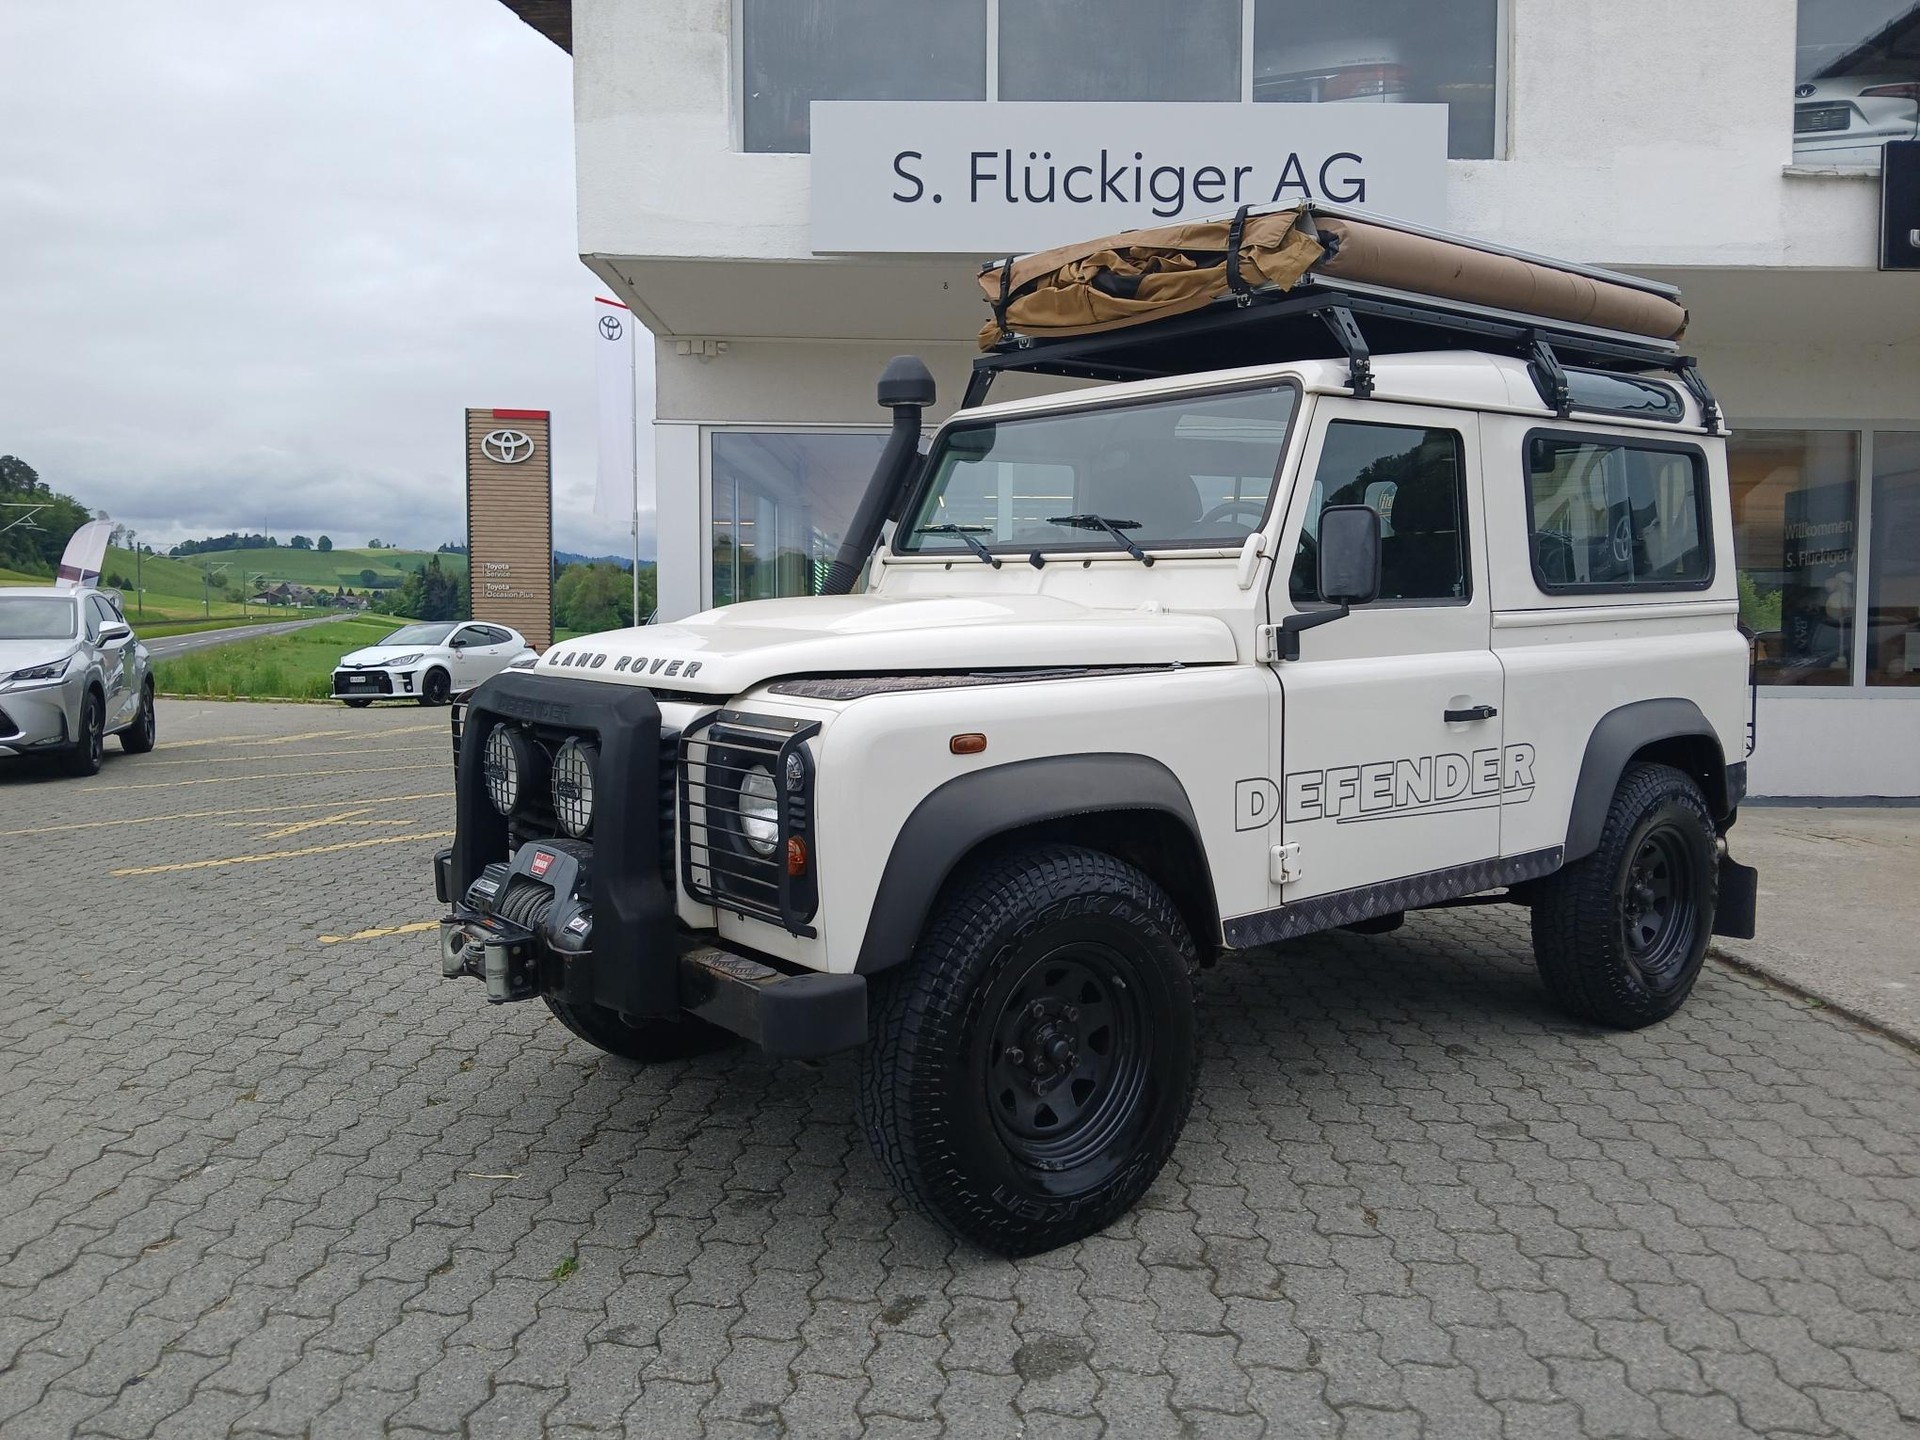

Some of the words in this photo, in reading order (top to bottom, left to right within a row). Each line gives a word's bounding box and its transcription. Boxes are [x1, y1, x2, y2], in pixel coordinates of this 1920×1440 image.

[893, 150, 942, 204] S.
[970, 149, 1253, 218] Flückiger
[1271, 152, 1366, 203] AG
[1784, 519, 1853, 541] Willkommen
[486, 563, 509, 571] Toyota
[1786, 551, 1797, 568] S.
[548, 651, 608, 669] LAND
[614, 655, 704, 679] ROVER
[1235, 742, 1536, 833] DEFENDER
